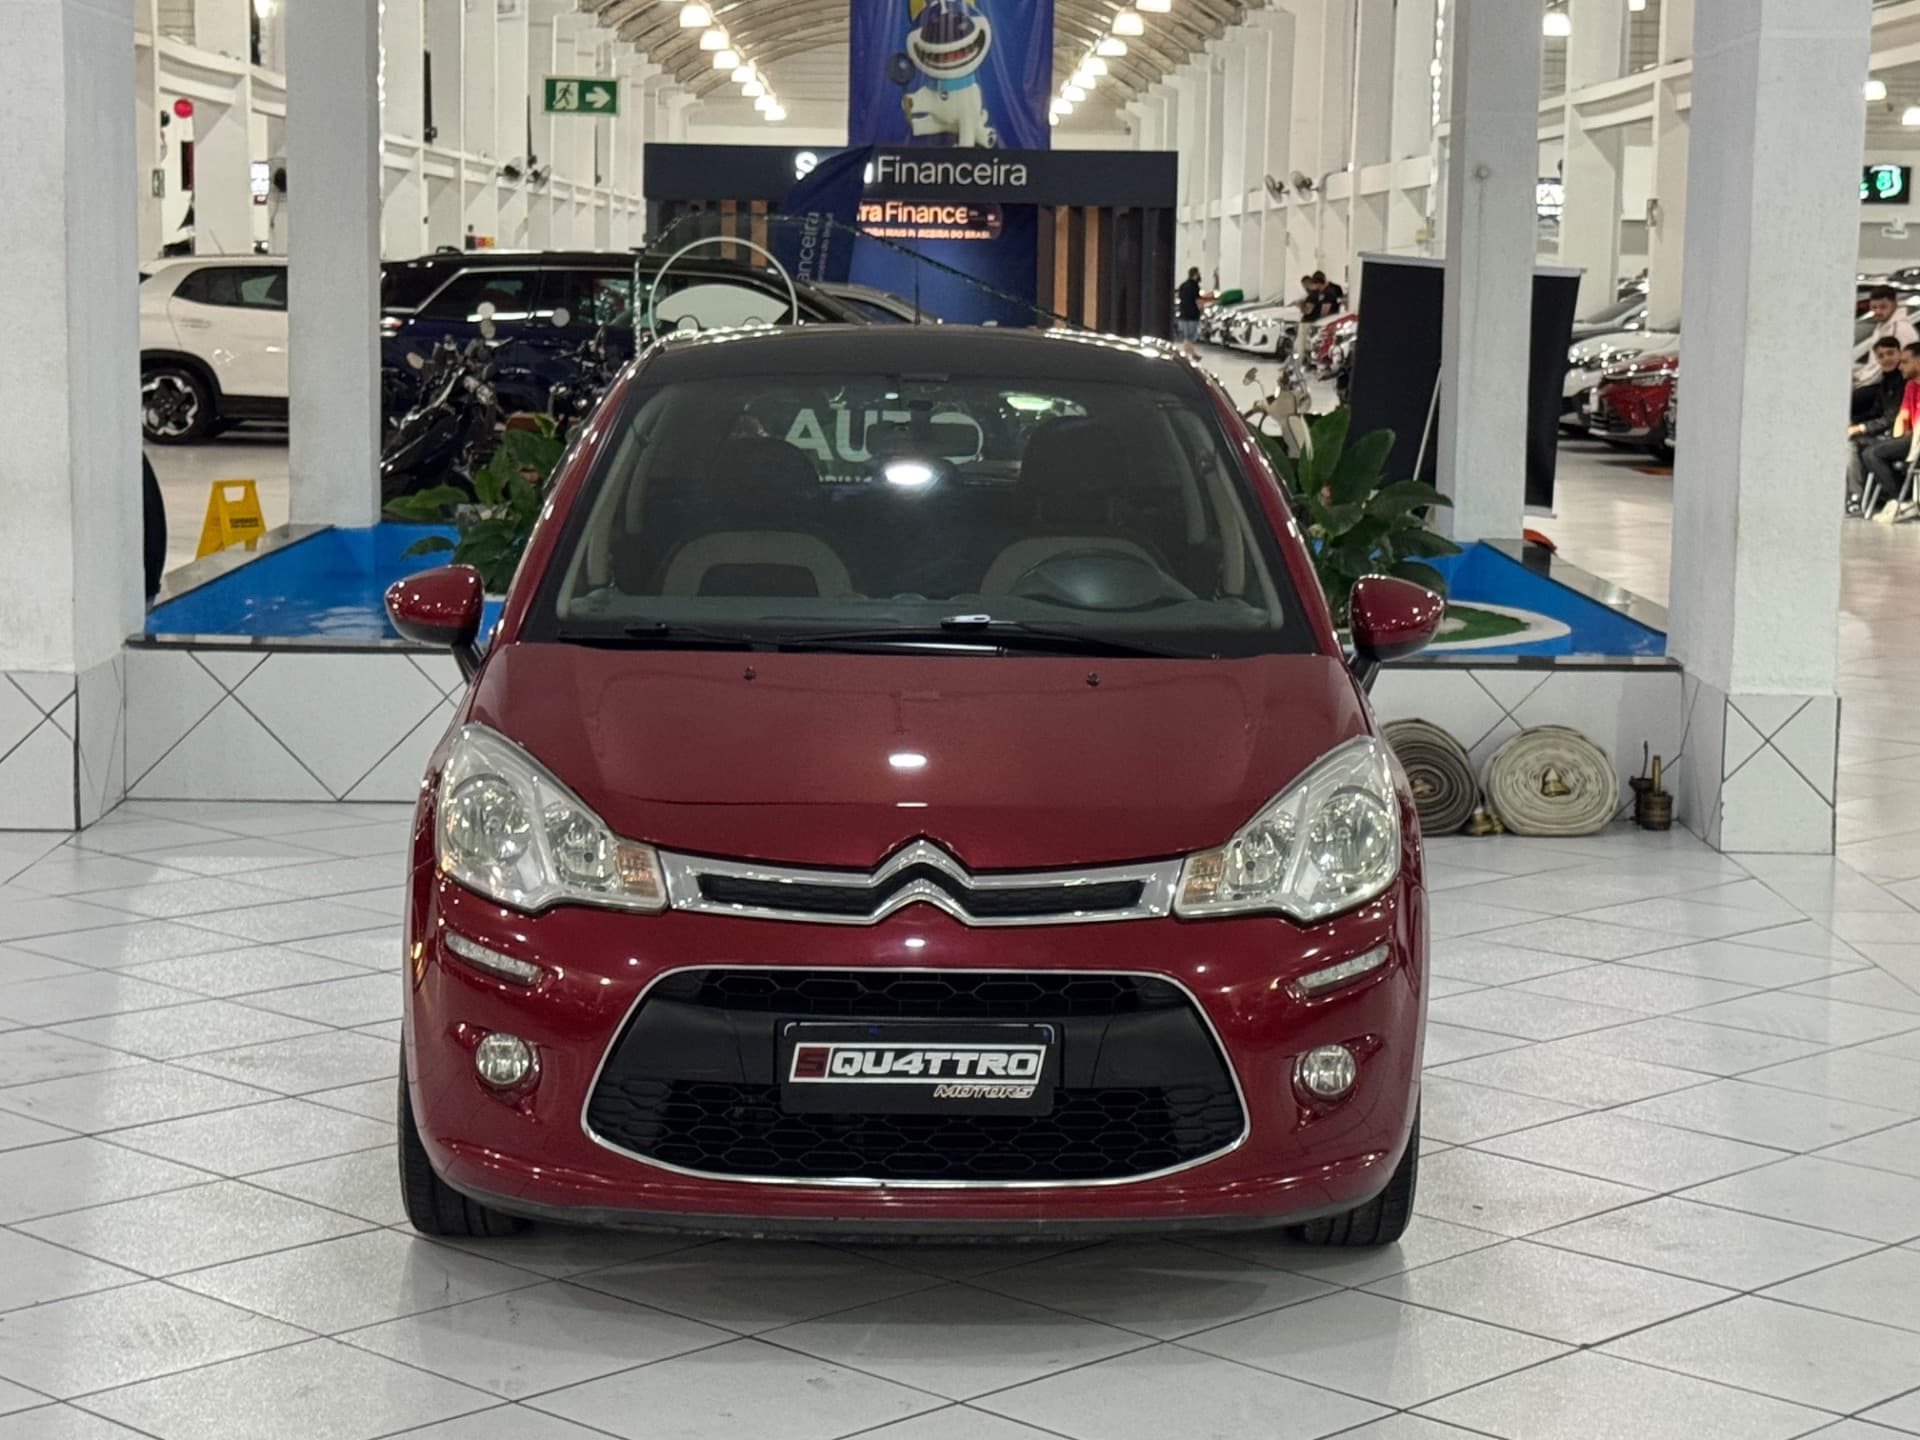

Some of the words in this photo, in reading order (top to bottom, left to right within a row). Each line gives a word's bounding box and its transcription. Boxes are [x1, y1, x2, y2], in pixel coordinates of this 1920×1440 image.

[877, 156, 1027, 185] Financeira
[885, 201, 969, 224] Finance
[796, 212, 820, 281] anceira
[831, 1051, 1039, 1076] QU4TTRO
[933, 1084, 1036, 1099] MOTORS
